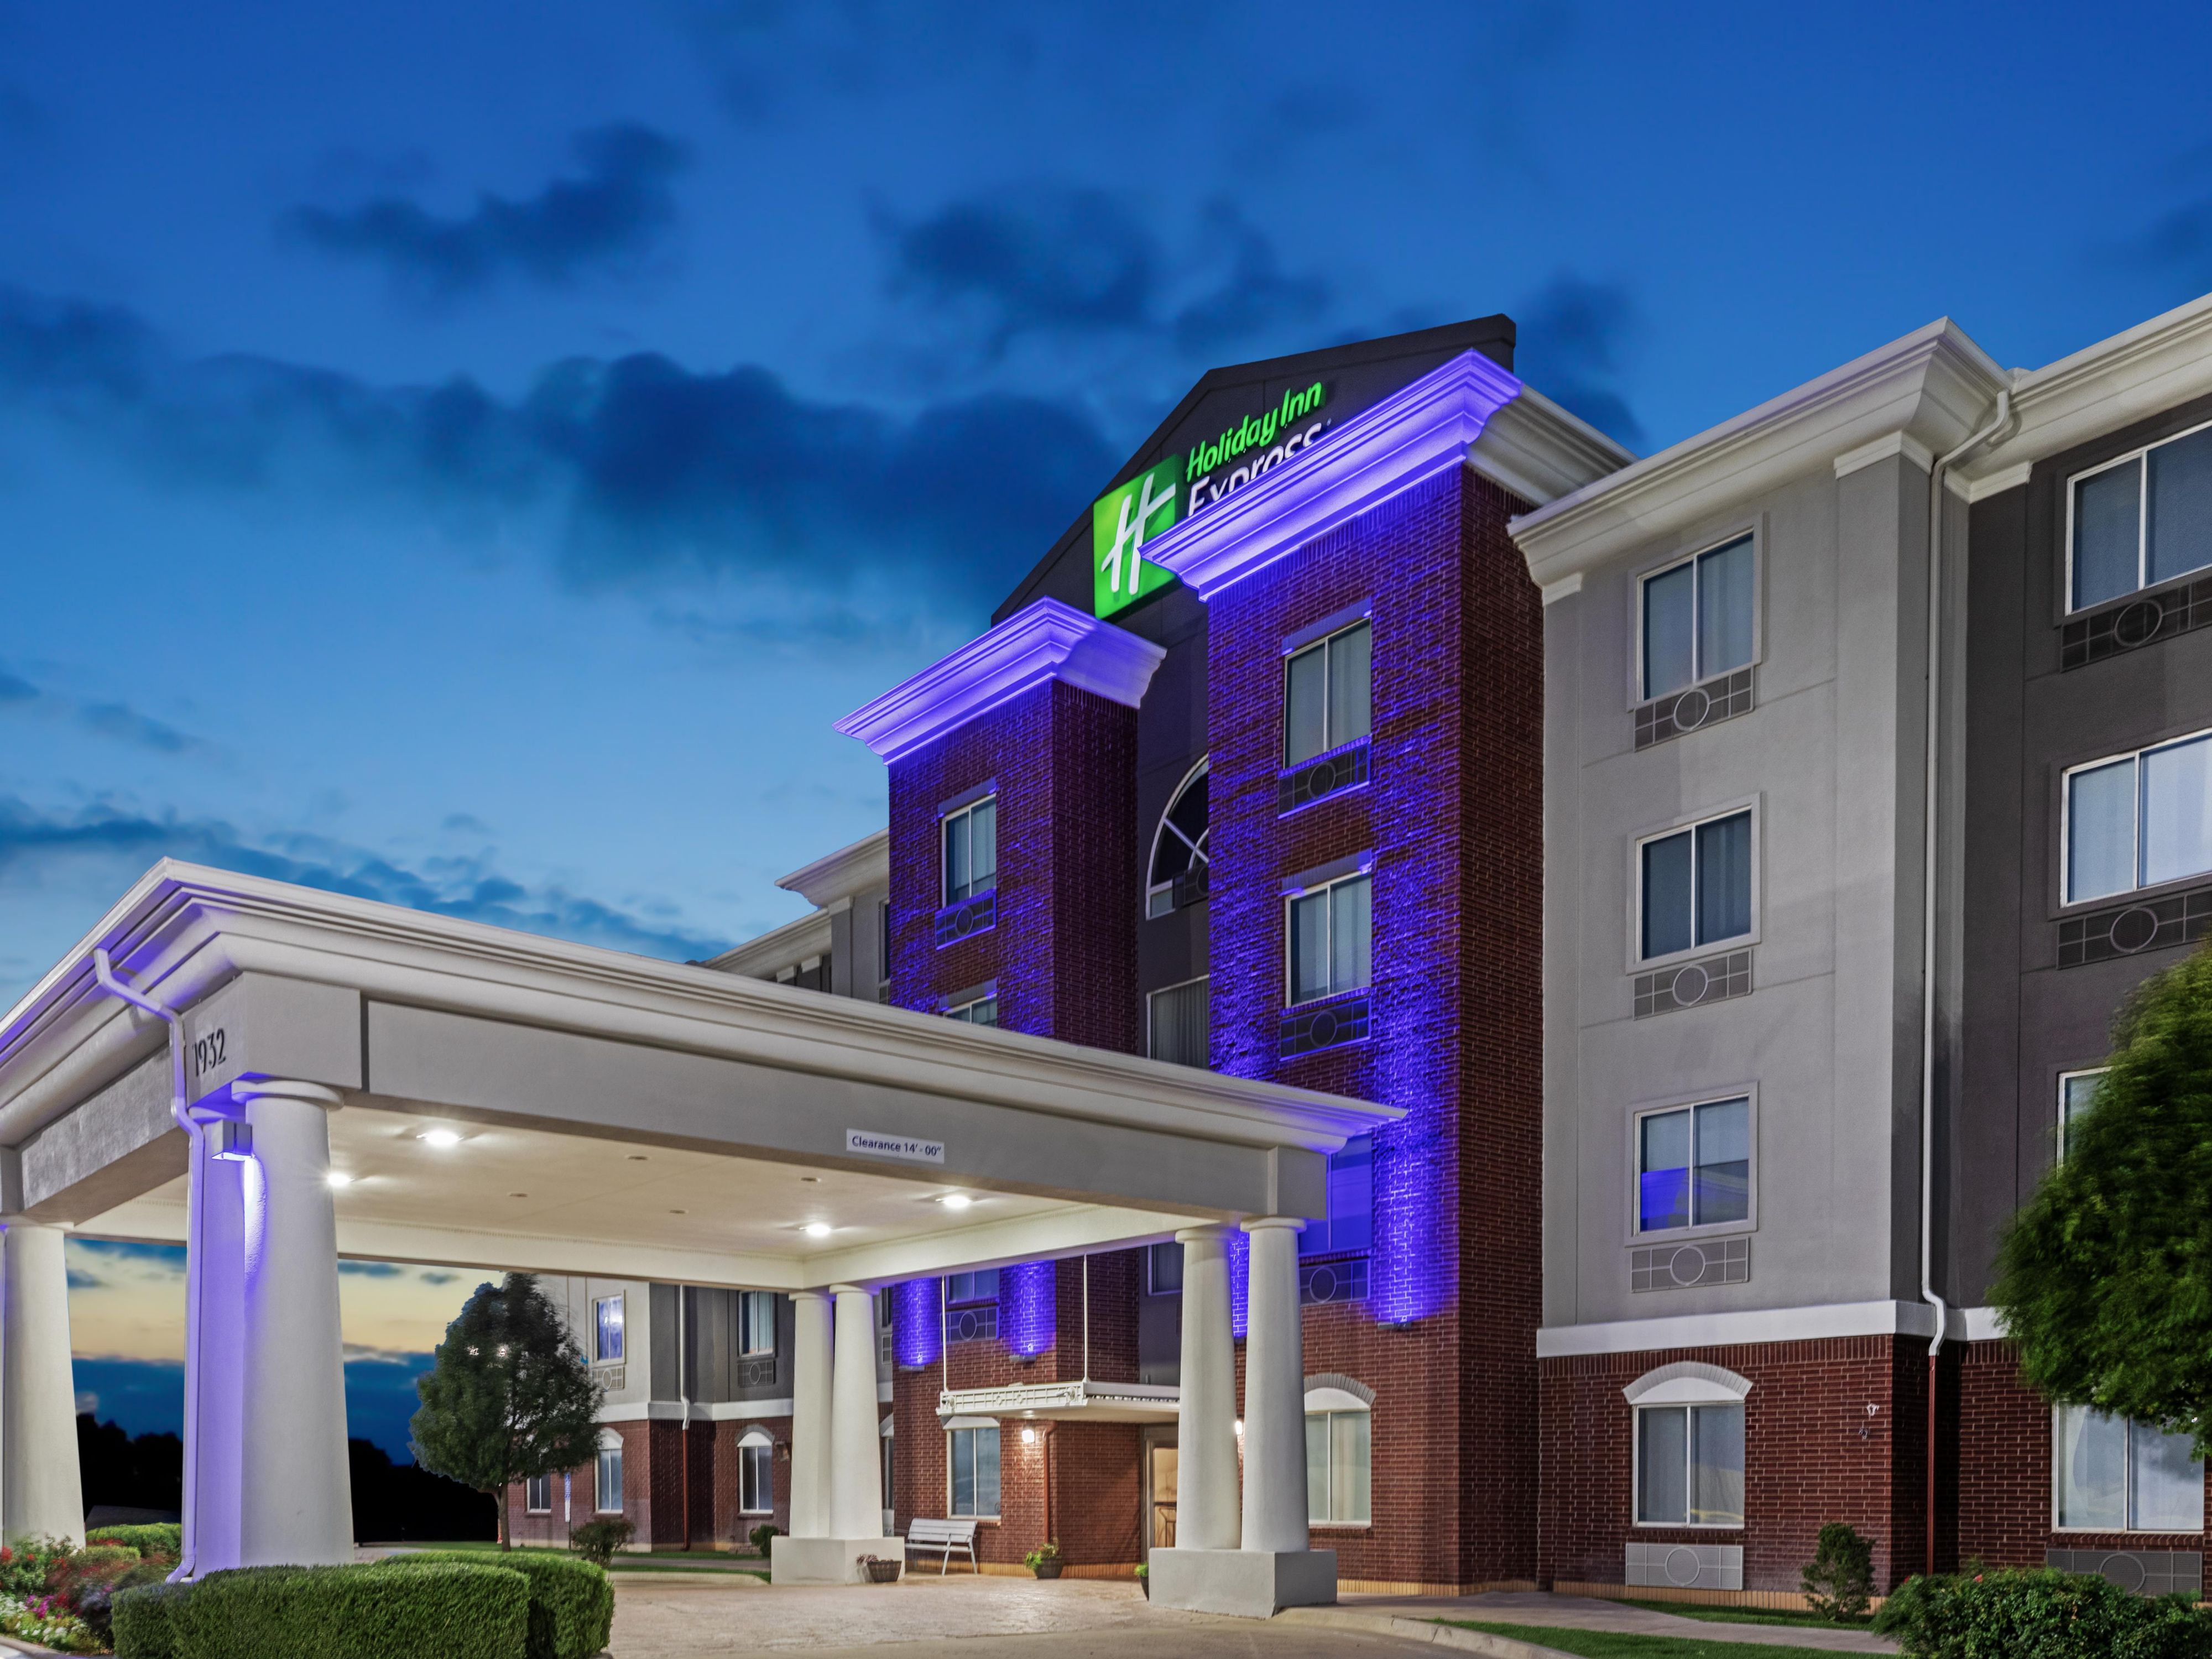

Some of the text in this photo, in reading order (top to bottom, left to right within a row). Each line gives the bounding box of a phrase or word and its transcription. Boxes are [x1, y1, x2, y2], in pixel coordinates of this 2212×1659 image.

[1186, 382, 1322, 482] Holiday Inn
[1100, 472, 1176, 596] H
[192, 1028, 226, 1077] 1932
[852, 1135, 901, 1152] Clearance
